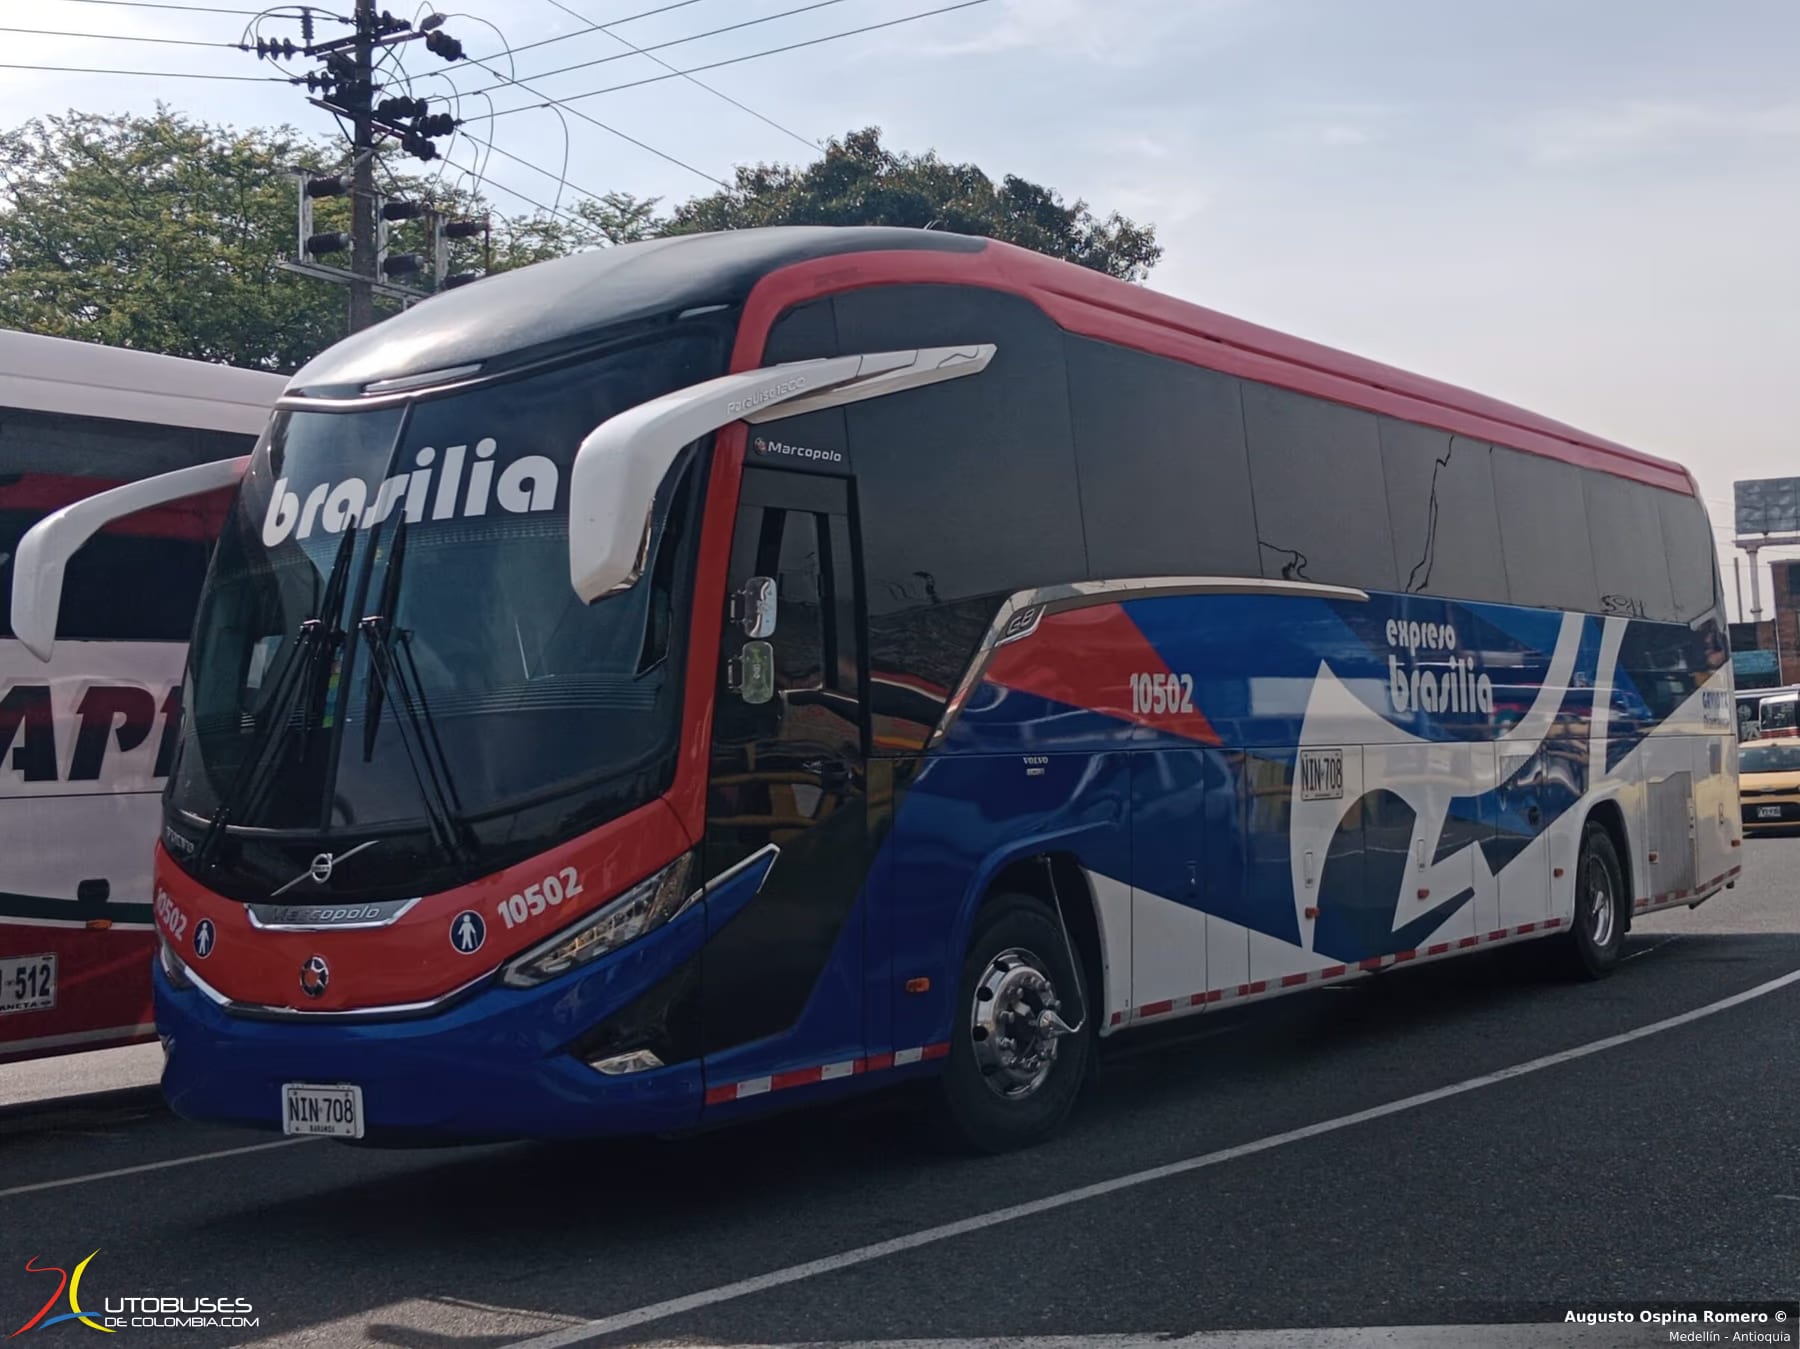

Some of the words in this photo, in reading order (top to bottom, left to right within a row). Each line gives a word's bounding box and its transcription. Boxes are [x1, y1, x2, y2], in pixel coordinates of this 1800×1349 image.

[768, 441, 842, 461] Marcopolo
[262, 437, 559, 547] brasilia
[1386, 619, 1456, 656] expreso
[1129, 672, 1193, 714] 10502
[1388, 654, 1493, 713] brasilia
[155, 887, 188, 941] 10502
[497, 866, 584, 929] 10502
